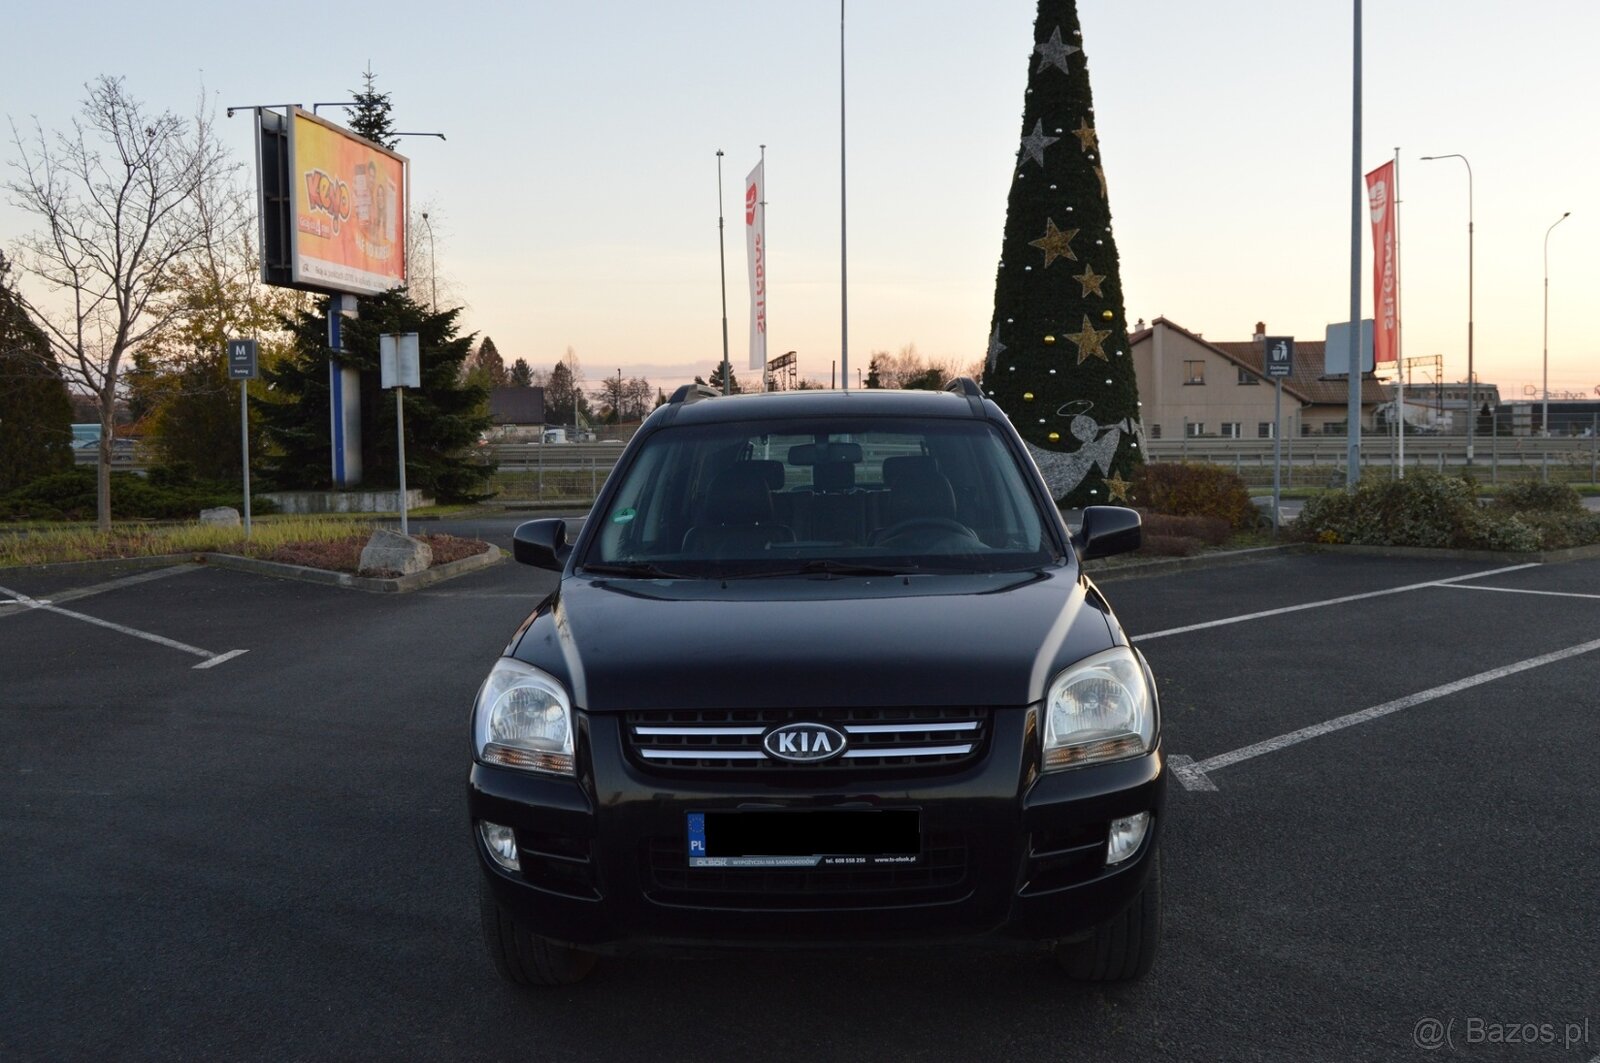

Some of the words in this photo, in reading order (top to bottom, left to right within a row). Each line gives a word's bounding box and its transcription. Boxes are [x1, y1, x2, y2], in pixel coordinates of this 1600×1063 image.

[235, 345, 246, 356] M
[779, 732, 832, 752] KIA
[691, 840, 705, 851] PL
